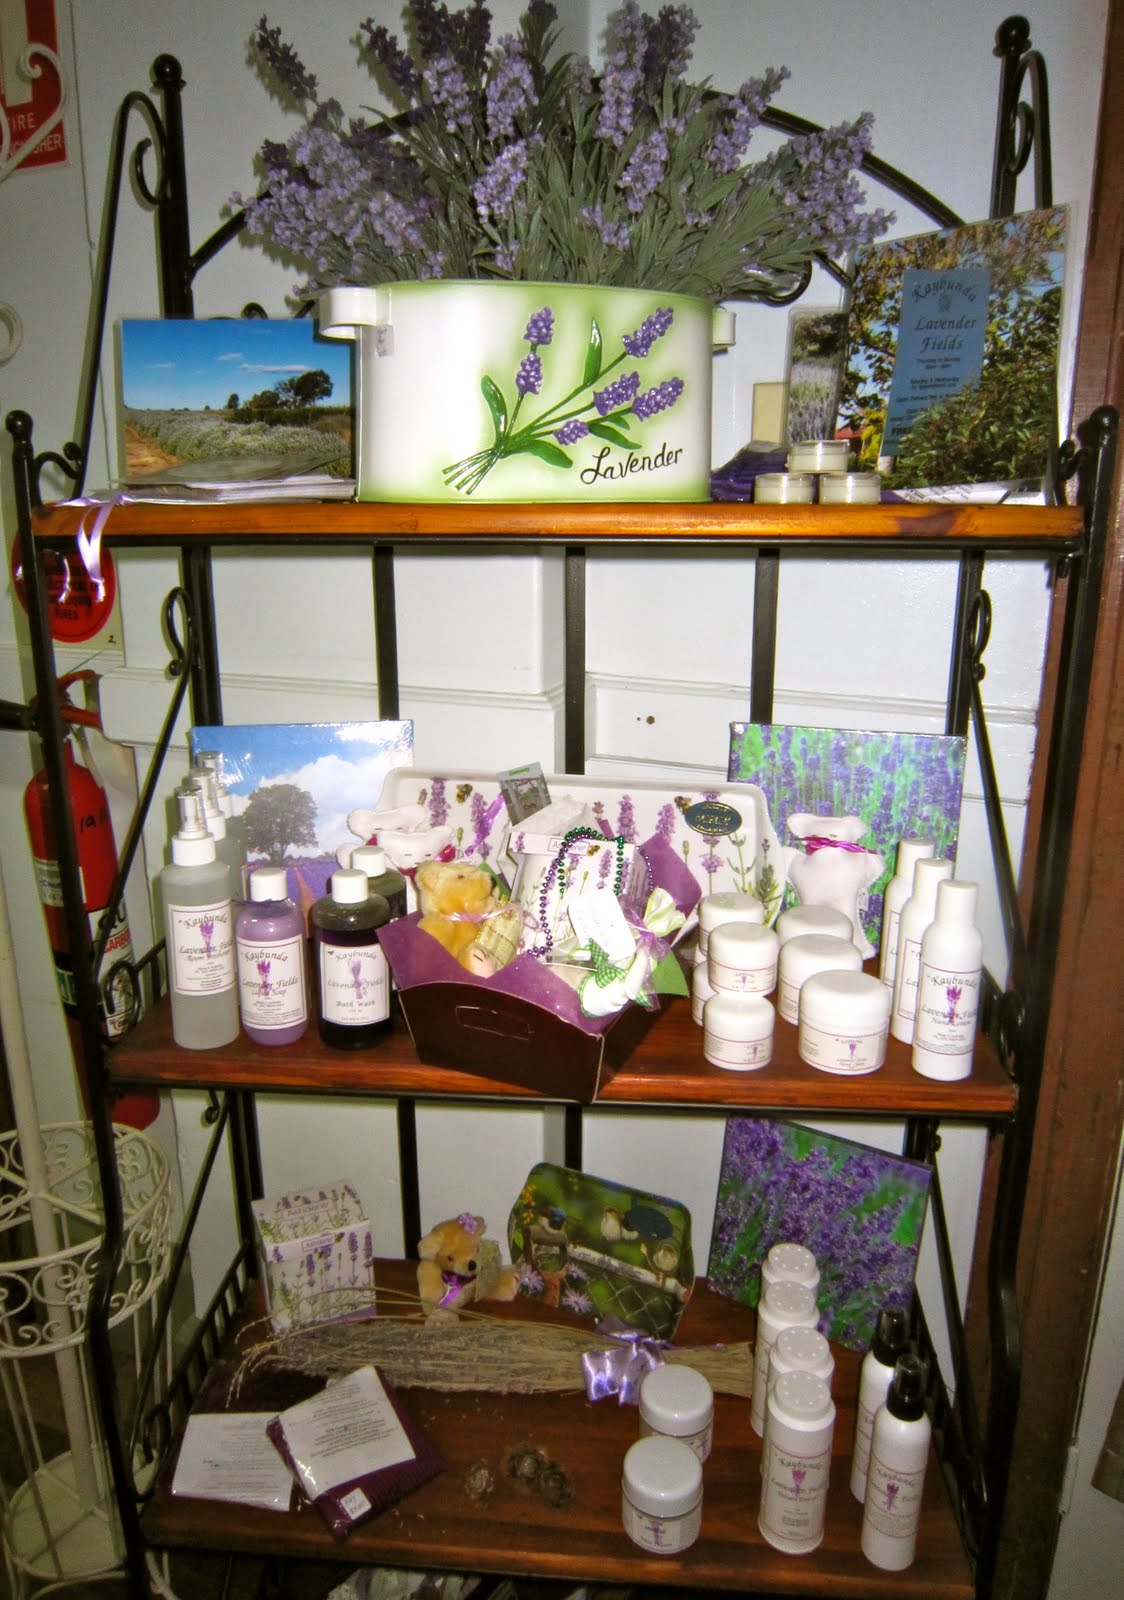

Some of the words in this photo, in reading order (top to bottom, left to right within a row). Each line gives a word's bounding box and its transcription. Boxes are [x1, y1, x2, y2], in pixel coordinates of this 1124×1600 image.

[8, 113, 36, 131] IRE
[914, 314, 977, 331] Lavender
[920, 335, 963, 353] Fields
[580, 442, 682, 485] Lavender
[245, 949, 288, 962] Kaybunda
